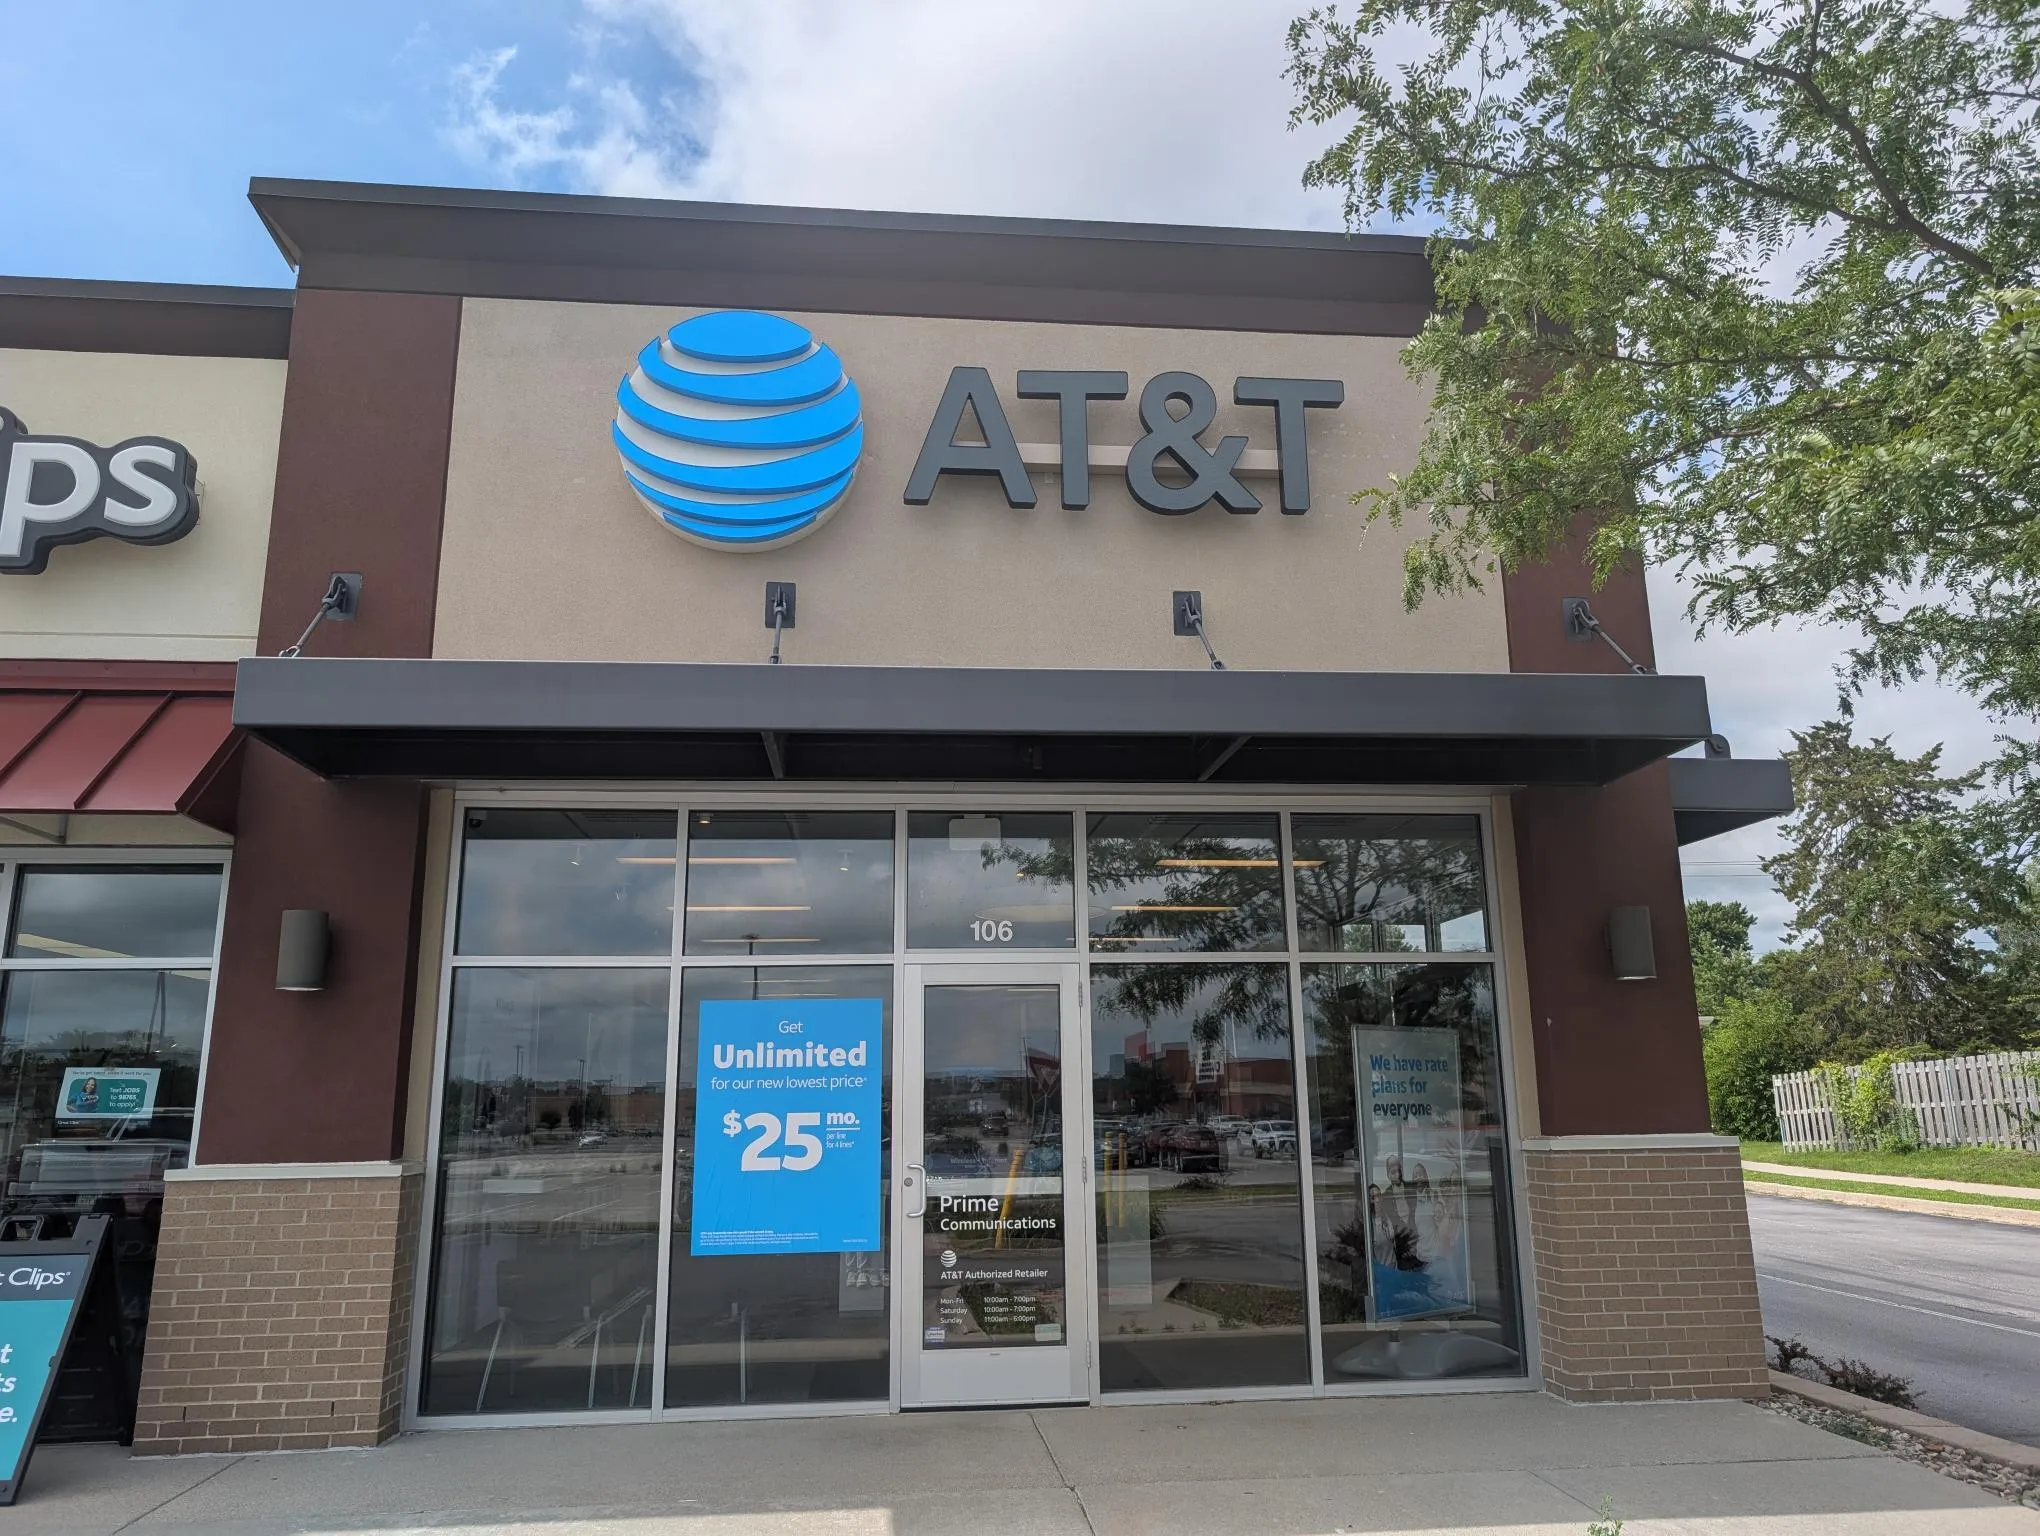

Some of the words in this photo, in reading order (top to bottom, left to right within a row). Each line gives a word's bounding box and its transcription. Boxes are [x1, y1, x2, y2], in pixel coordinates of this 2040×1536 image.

[903, 366, 1344, 515] AT&T
[0, 436, 177, 557] ps
[970, 920, 1013, 942] 106
[778, 1020, 803, 1034] Get
[713, 1040, 867, 1069] Unlimited
[1370, 1054, 1391, 1071] We
[1393, 1054, 1422, 1072] have
[1424, 1057, 1449, 1072] rate
[711, 1077, 729, 1090] for
[732, 1079, 754, 1089] our
[757, 1079, 783, 1089] new
[786, 1076, 827, 1089] lowest
[1372, 1075, 1407, 1098] plans
[1409, 1076, 1428, 1093] for
[1373, 1103, 1433, 1120] everyone
[723, 1109, 823, 1172] $25
[826, 1111, 861, 1125] mo.
[826, 1141, 834, 1149] for
[940, 1194, 999, 1213] Prime
[940, 1216, 1057, 1231] Communications
[940, 1271, 963, 1280] AT&T
[965, 1269, 1013, 1279] Authorized
[1014, 1269, 1049, 1278] Retailer
[940, 1307, 968, 1315] Saturday
[940, 1317, 963, 1325] Sunday
